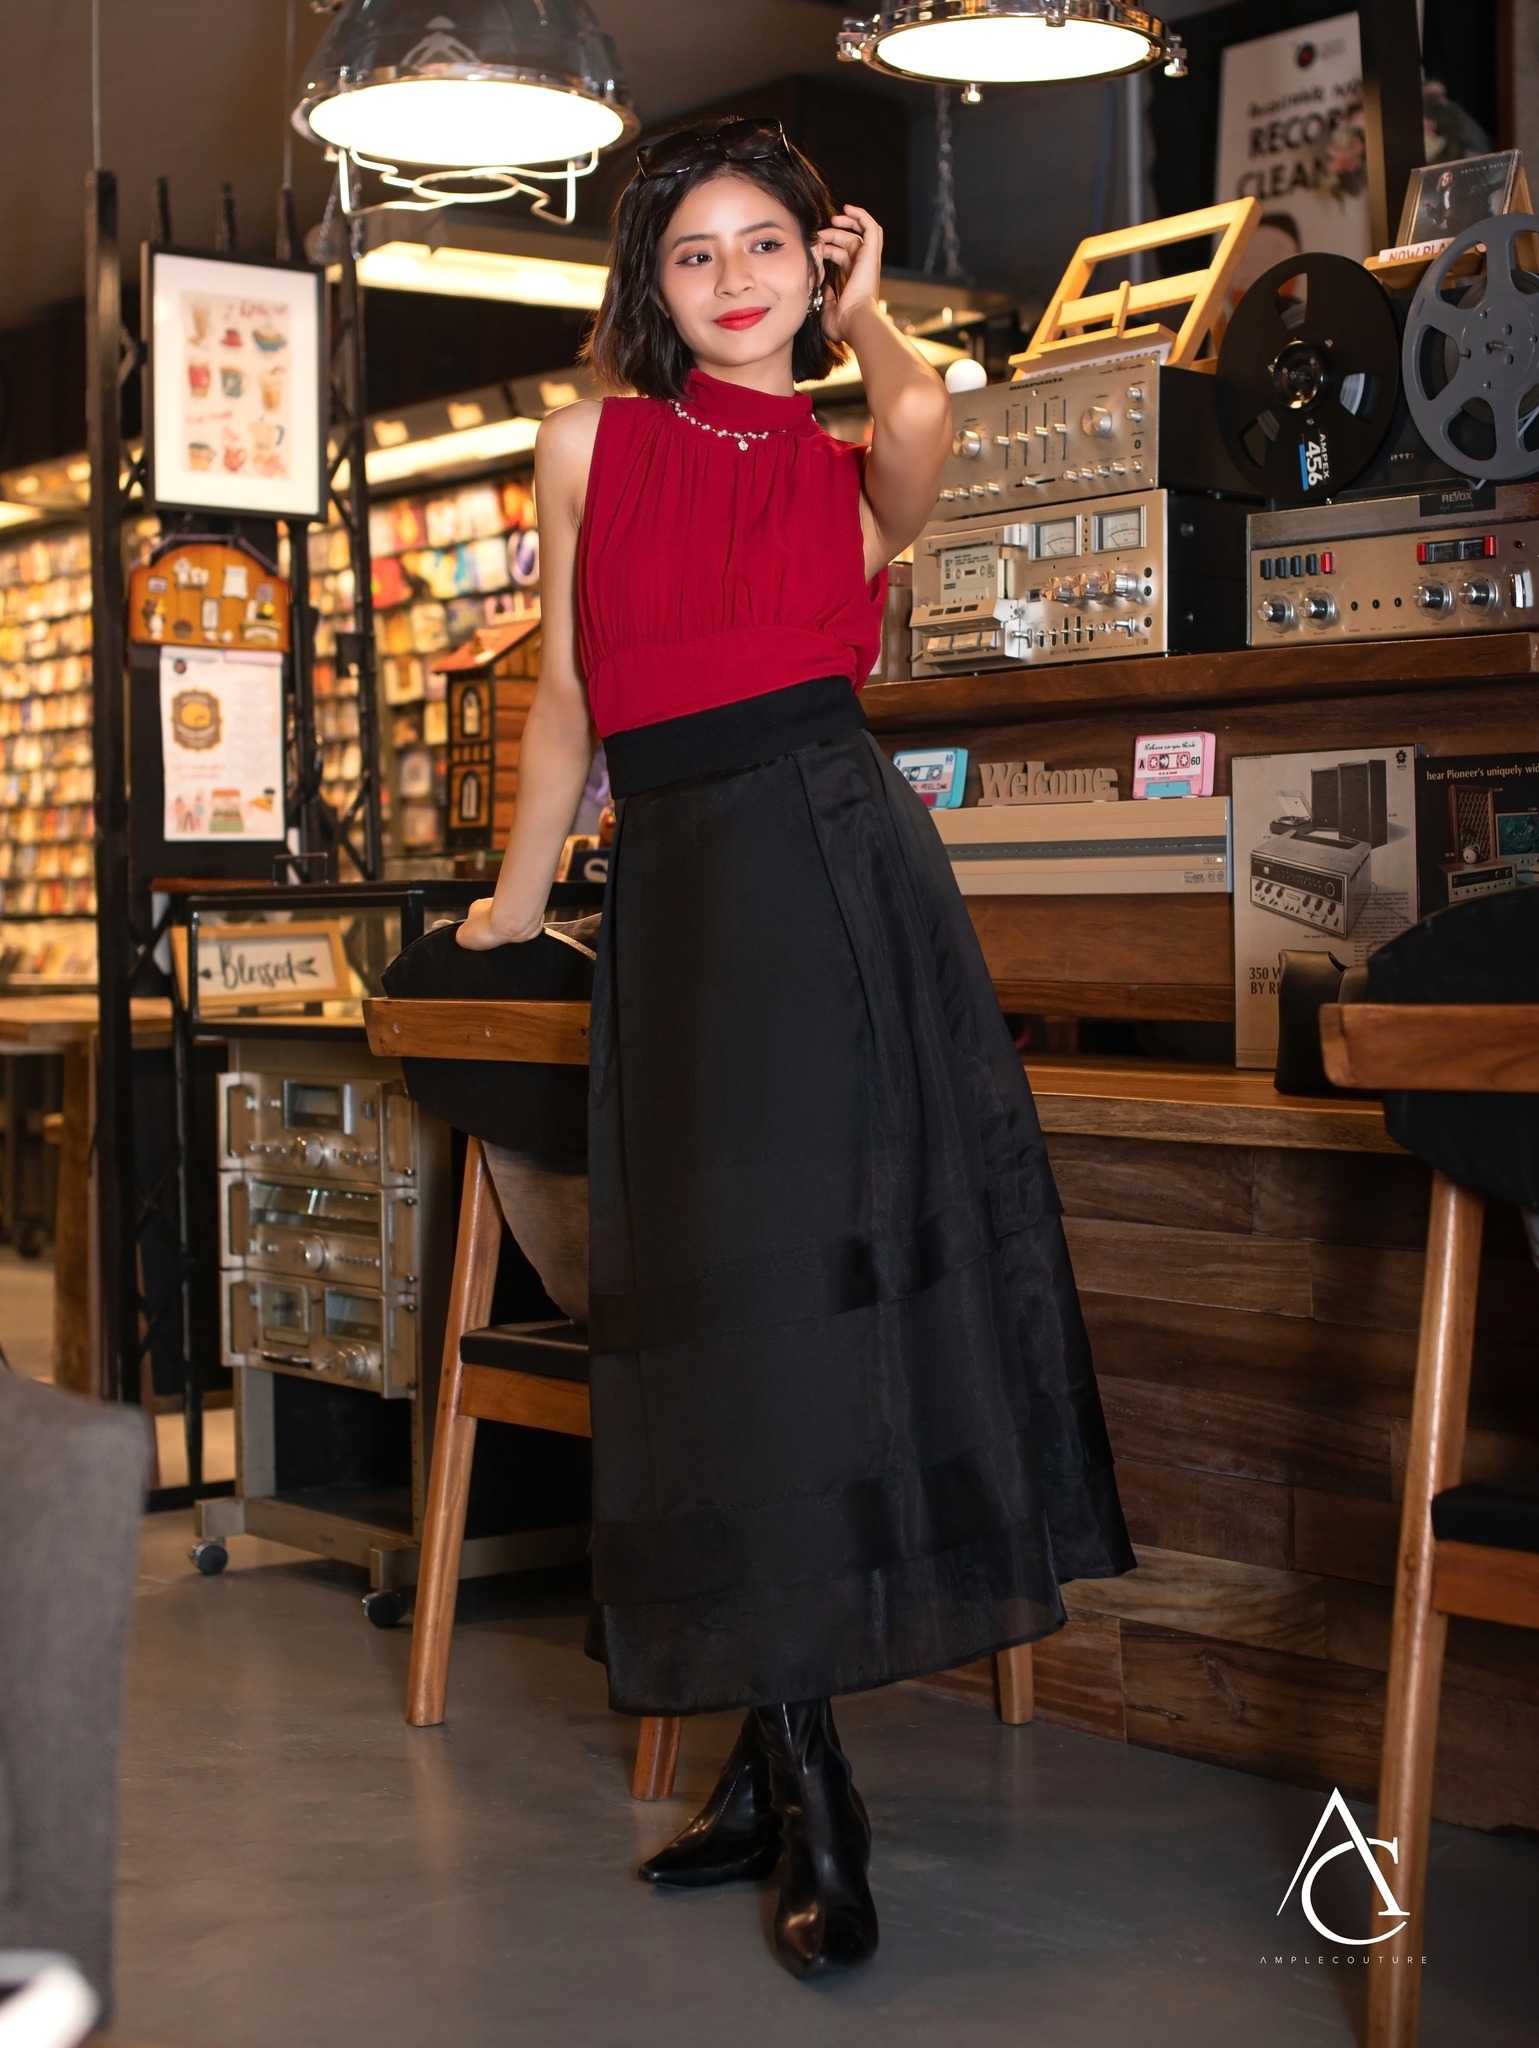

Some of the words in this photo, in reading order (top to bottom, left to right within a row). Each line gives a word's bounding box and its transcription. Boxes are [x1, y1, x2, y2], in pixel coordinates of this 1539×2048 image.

[1423, 241, 1451, 256] PLA
[1305, 441, 1323, 486] 456
[1319, 433, 1330, 479] AMPEX
[945, 754, 954, 763] 60
[1139, 760, 1145, 769] A
[1190, 756, 1201, 766] 60
[1426, 770, 1445, 781] hear
[1446, 767, 1484, 780] Pioneer's
[1486, 764, 1523, 778] uniquely
[978, 761, 1119, 800] Welcome
[218, 943, 298, 991] Blessed
[1249, 967, 1269, 980] 350
[1250, 982, 1266, 995] BY
